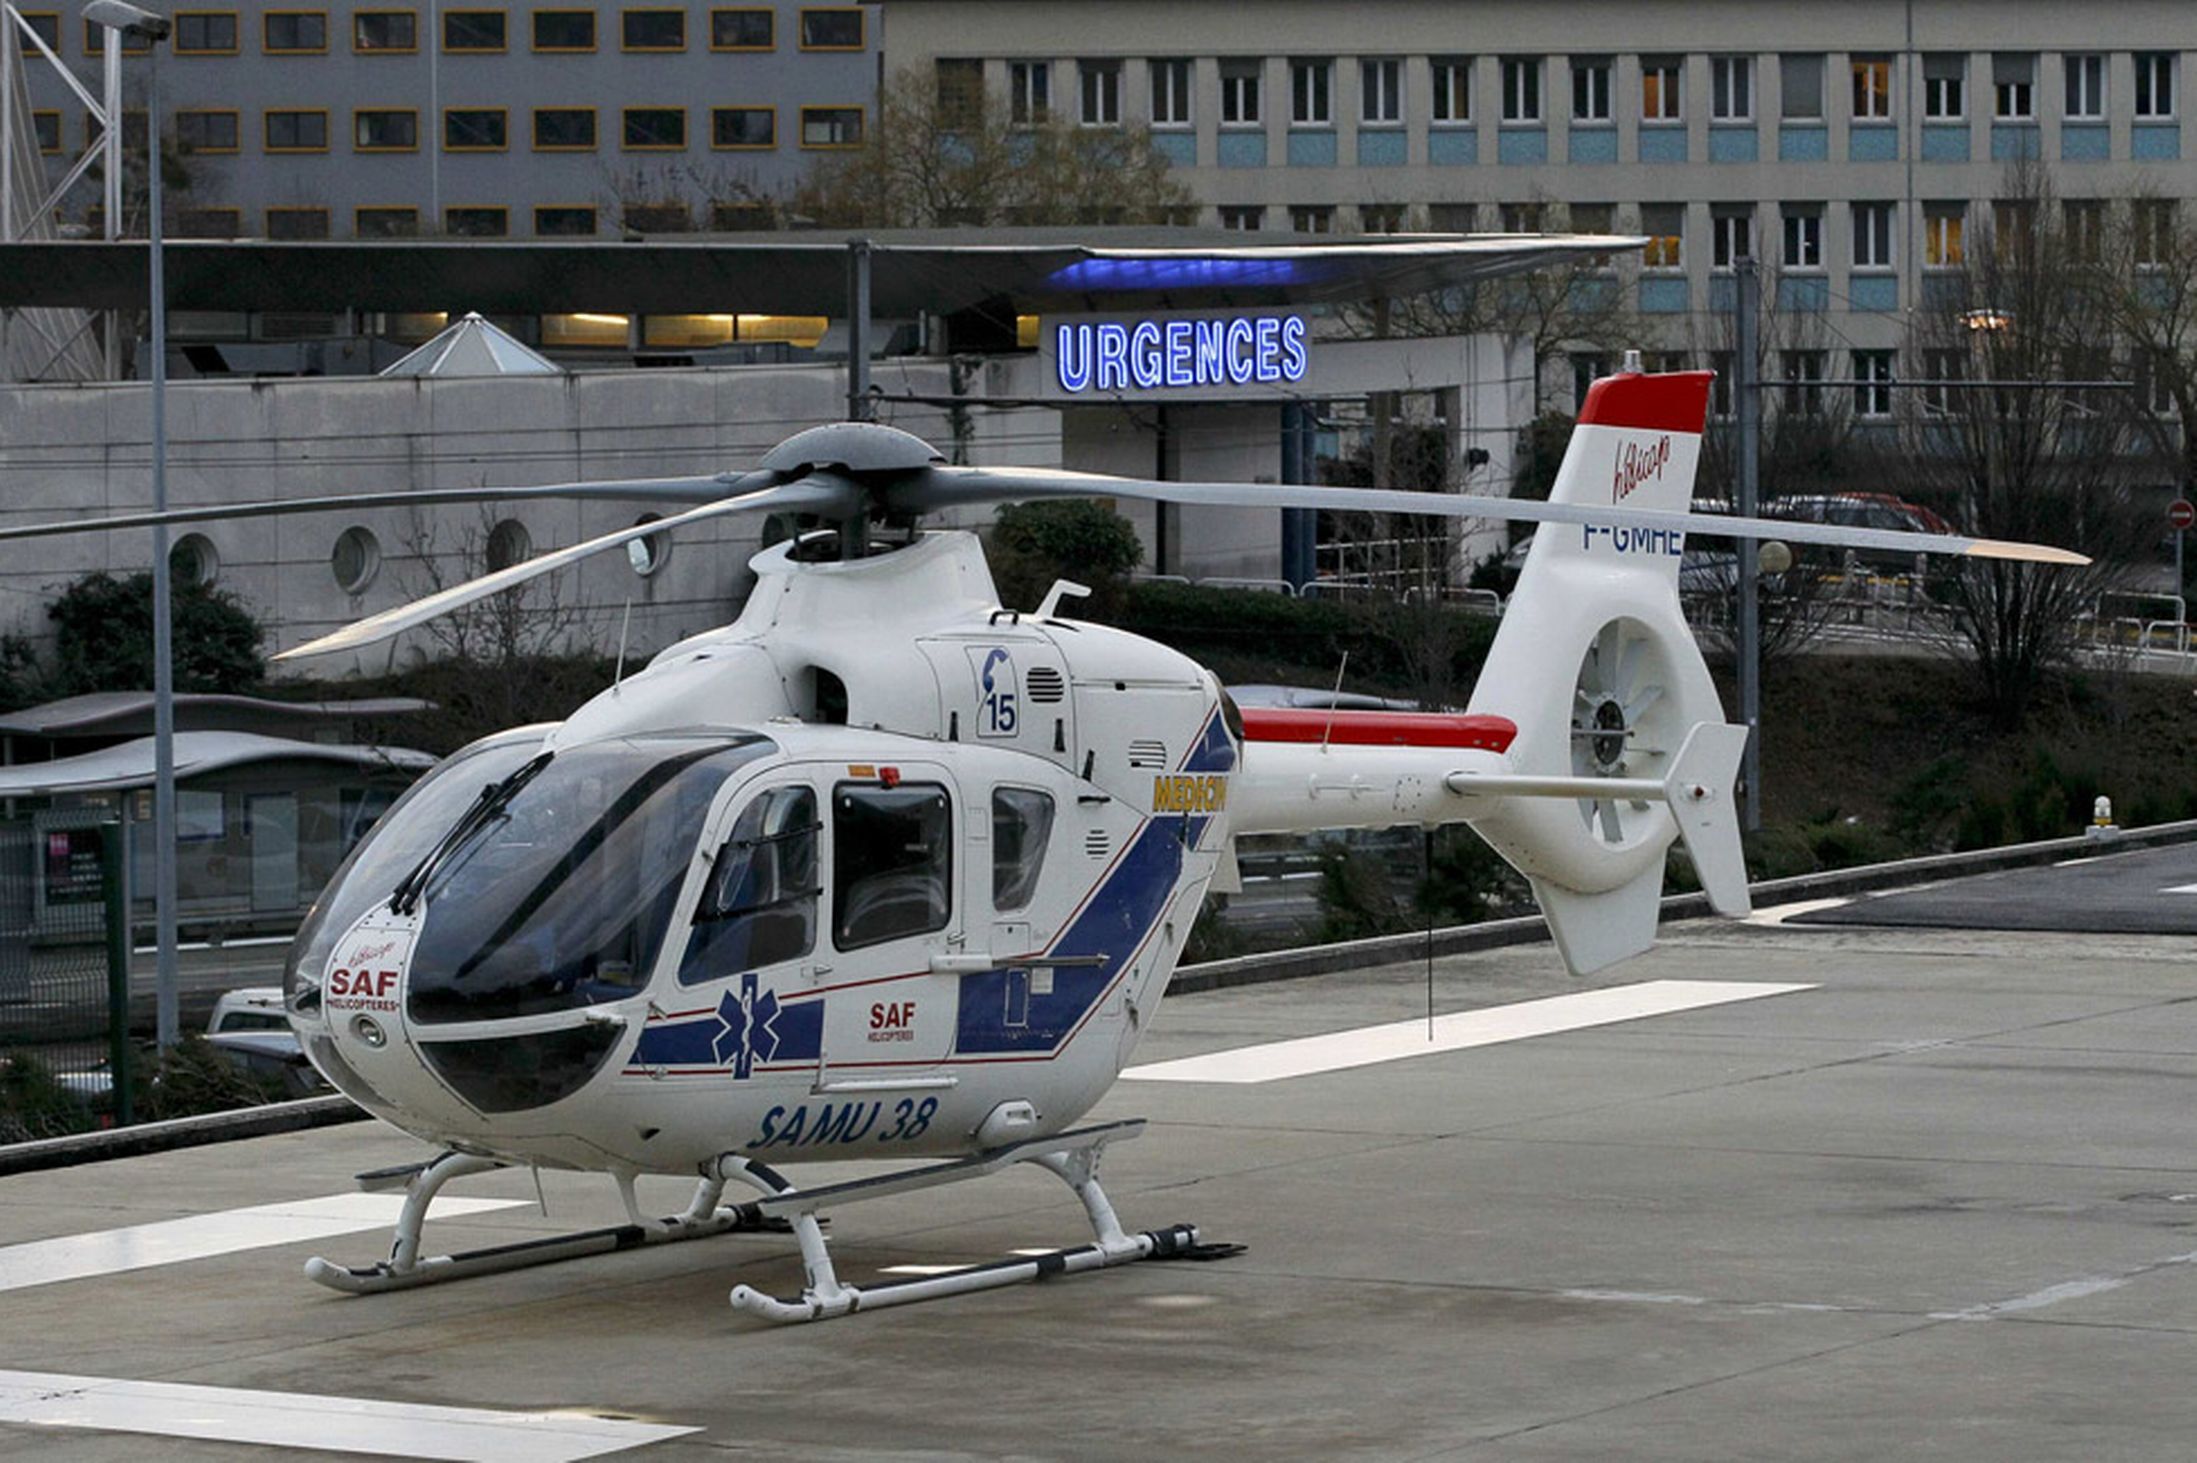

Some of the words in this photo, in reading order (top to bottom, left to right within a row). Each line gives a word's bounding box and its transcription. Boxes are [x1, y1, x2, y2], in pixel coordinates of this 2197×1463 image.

[1058, 315, 1307, 392] URGENCES
[986, 693, 1015, 731] 15
[330, 969, 398, 997] SAF
[869, 1002, 916, 1029] SAF
[747, 1101, 882, 1149] SAMU
[878, 1096, 939, 1142] 38
